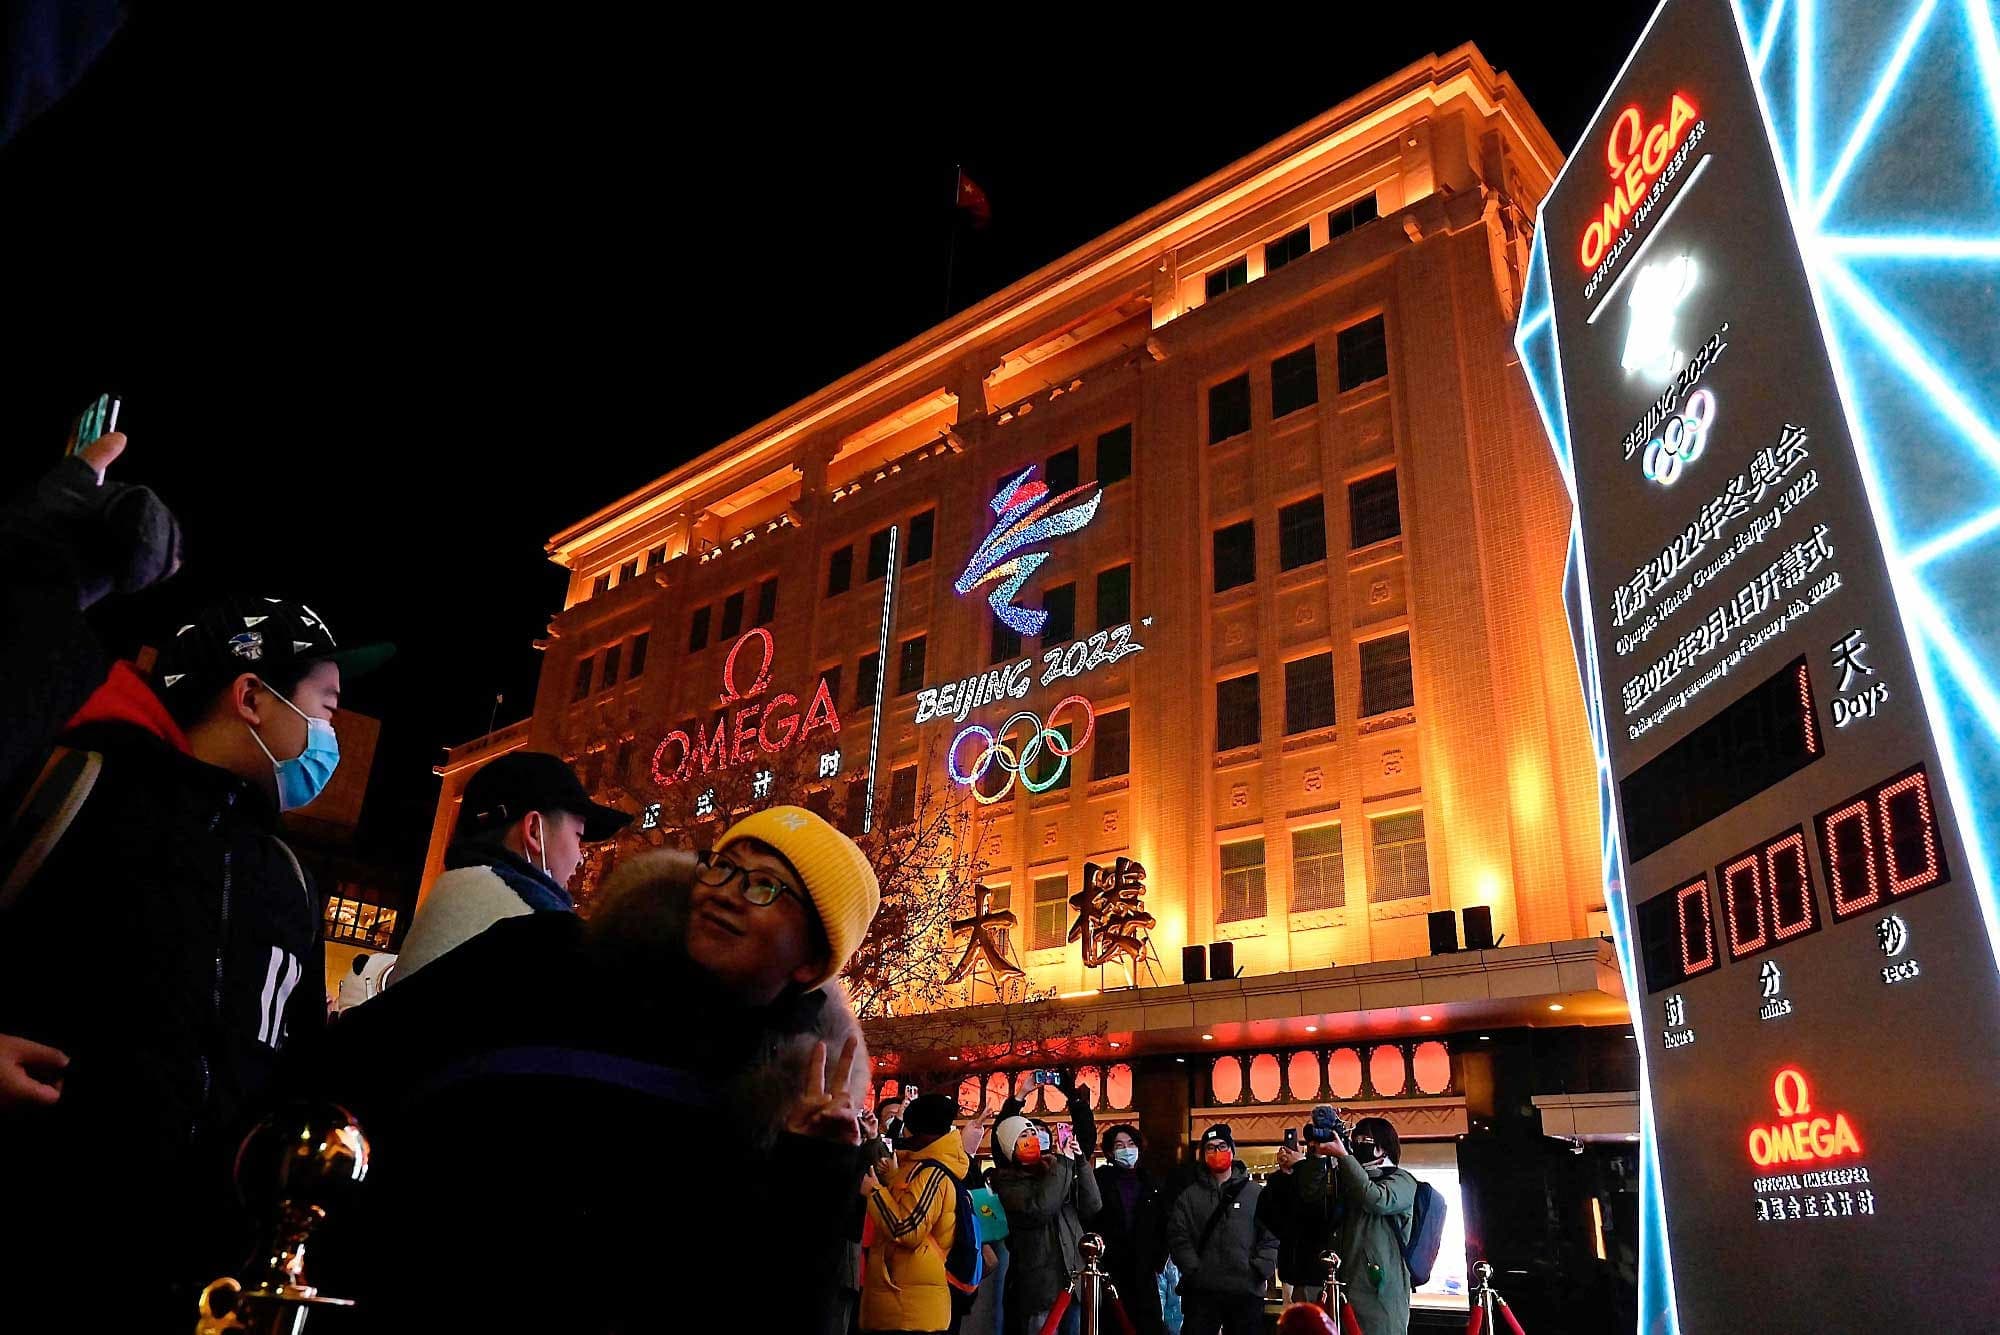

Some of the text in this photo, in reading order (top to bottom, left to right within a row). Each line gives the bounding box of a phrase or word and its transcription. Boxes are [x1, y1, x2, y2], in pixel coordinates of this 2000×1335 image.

[1581, 94, 1696, 268] OMEGA
[1584, 229, 1634, 300] OFFICIAL
[1622, 333, 1729, 461] BEIJING 2022
[1609, 422, 1810, 628] 北京2022年冬奥会
[1616, 469, 1819, 656] Olympic Winter Games Beijing 2022
[914, 658, 1032, 724] BEIJING
[1040, 623, 1145, 687] 2022
[1651, 691, 1686, 724] opening
[1807, 571, 1843, 605] 2022
[1830, 629, 1876, 691] 天
[650, 677, 842, 788] OMEGA
[1798, 664, 1817, 755] 1
[1830, 683, 1889, 728] Days
[1677, 771, 1940, 977] 0 00 00
[1759, 960, 1781, 998] 分
[1760, 998, 1792, 1020] mins
[1879, 958, 1921, 985] secs
[1749, 1113, 1861, 1167] OMEGA
[1753, 1175, 1802, 1193] OFFICIAL
